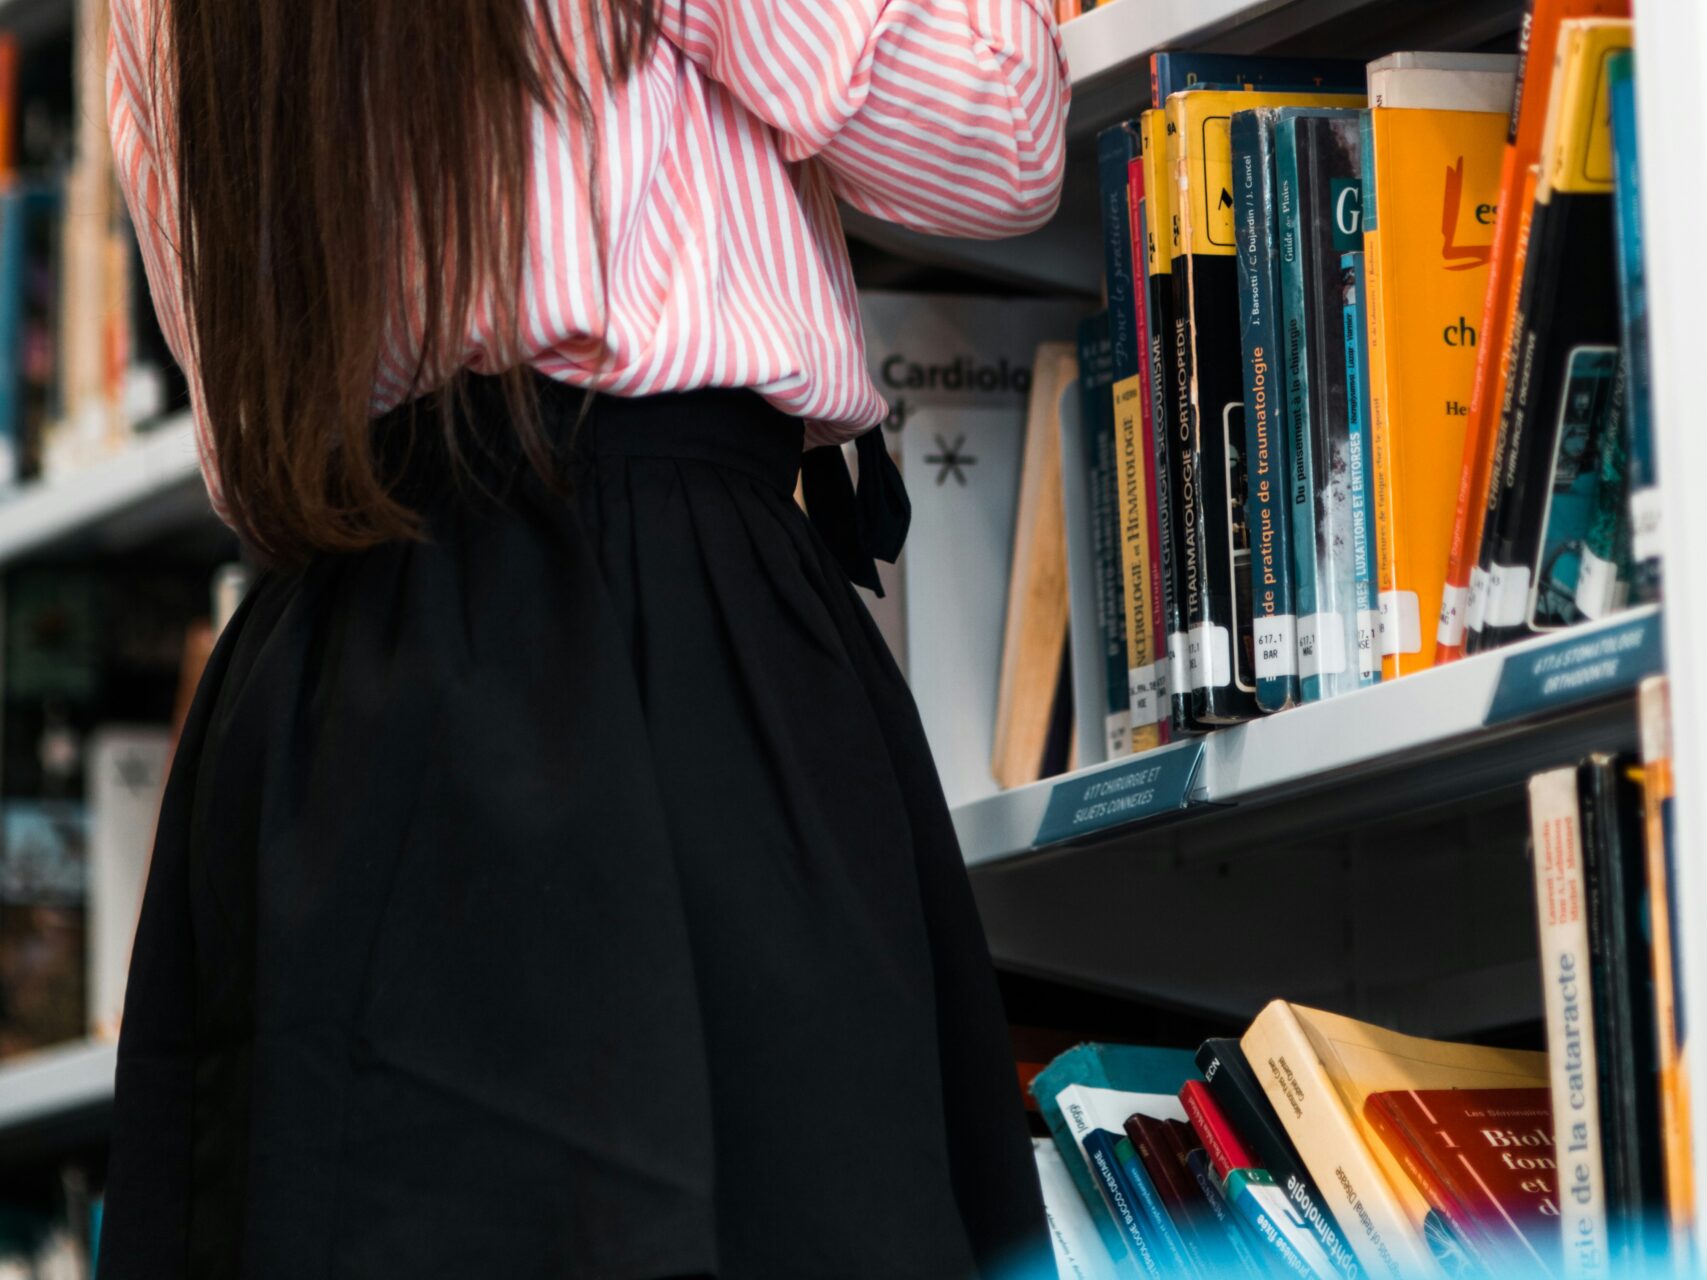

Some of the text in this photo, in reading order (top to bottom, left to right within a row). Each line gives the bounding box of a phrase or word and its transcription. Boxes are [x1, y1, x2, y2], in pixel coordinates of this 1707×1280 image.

[1519, 12, 1533, 53] ECN
[1106, 191, 1131, 280] praticien
[1244, 155, 1260, 326] J. Barsotti C. Dujardin J. Cancel
[1281, 179, 1294, 263] Guide Plaies
[1112, 286, 1126, 306] le
[1288, 319, 1301, 375] chirurgie
[1443, 315, 1478, 348] ch
[880, 353, 1035, 393] Cardiolo
[1290, 380, 1300, 394] la
[1488, 414, 1507, 510] CHIRURGIE
[1502, 311, 1525, 413] VASCULAIRE
[1505, 330, 1536, 488] CHIRURGIE DIGESTIVE
[1176, 317, 1198, 616] TRAUMATOLOGIE ORTHOPEDIE
[1253, 346, 1275, 584] pratique de traumatologie
[1292, 410, 1307, 484] pansement
[1122, 415, 1140, 544] HÉMATOLOGIE
[1151, 334, 1175, 625] PETITE CHIRURGIE SECOURISME
[1295, 488, 1306, 505] Du
[1349, 432, 1367, 577] LUXATIONS ET ENTORSES
[1459, 464, 1470, 503] Dagher
[1128, 562, 1146, 667] NCÉROLOGIE
[1152, 564, 1162, 627] Chirurgie
[1259, 633, 1283, 645] 617.1
[1263, 649, 1278, 660] BAR
[1100, 769, 1147, 796] CHIRURGIE
[1146, 766, 1162, 783] ET
[1106, 788, 1155, 816] CONNEXES
[1205, 1057, 1221, 1083] ECN
[1264, 1057, 1283, 1079] Cohen
[1557, 951, 1592, 1206] de la cataracte
[1067, 1103, 1089, 1134] Jaeggi
[1094, 1149, 1136, 1228] BUCCO-DENTAIRE
[1334, 1165, 1382, 1244] of Retinal Disease
[1520, 1176, 1552, 1194] et
[1256, 1213, 1307, 1273] prothèse fixée
[1286, 1175, 1359, 1280] Ophtalmologie
